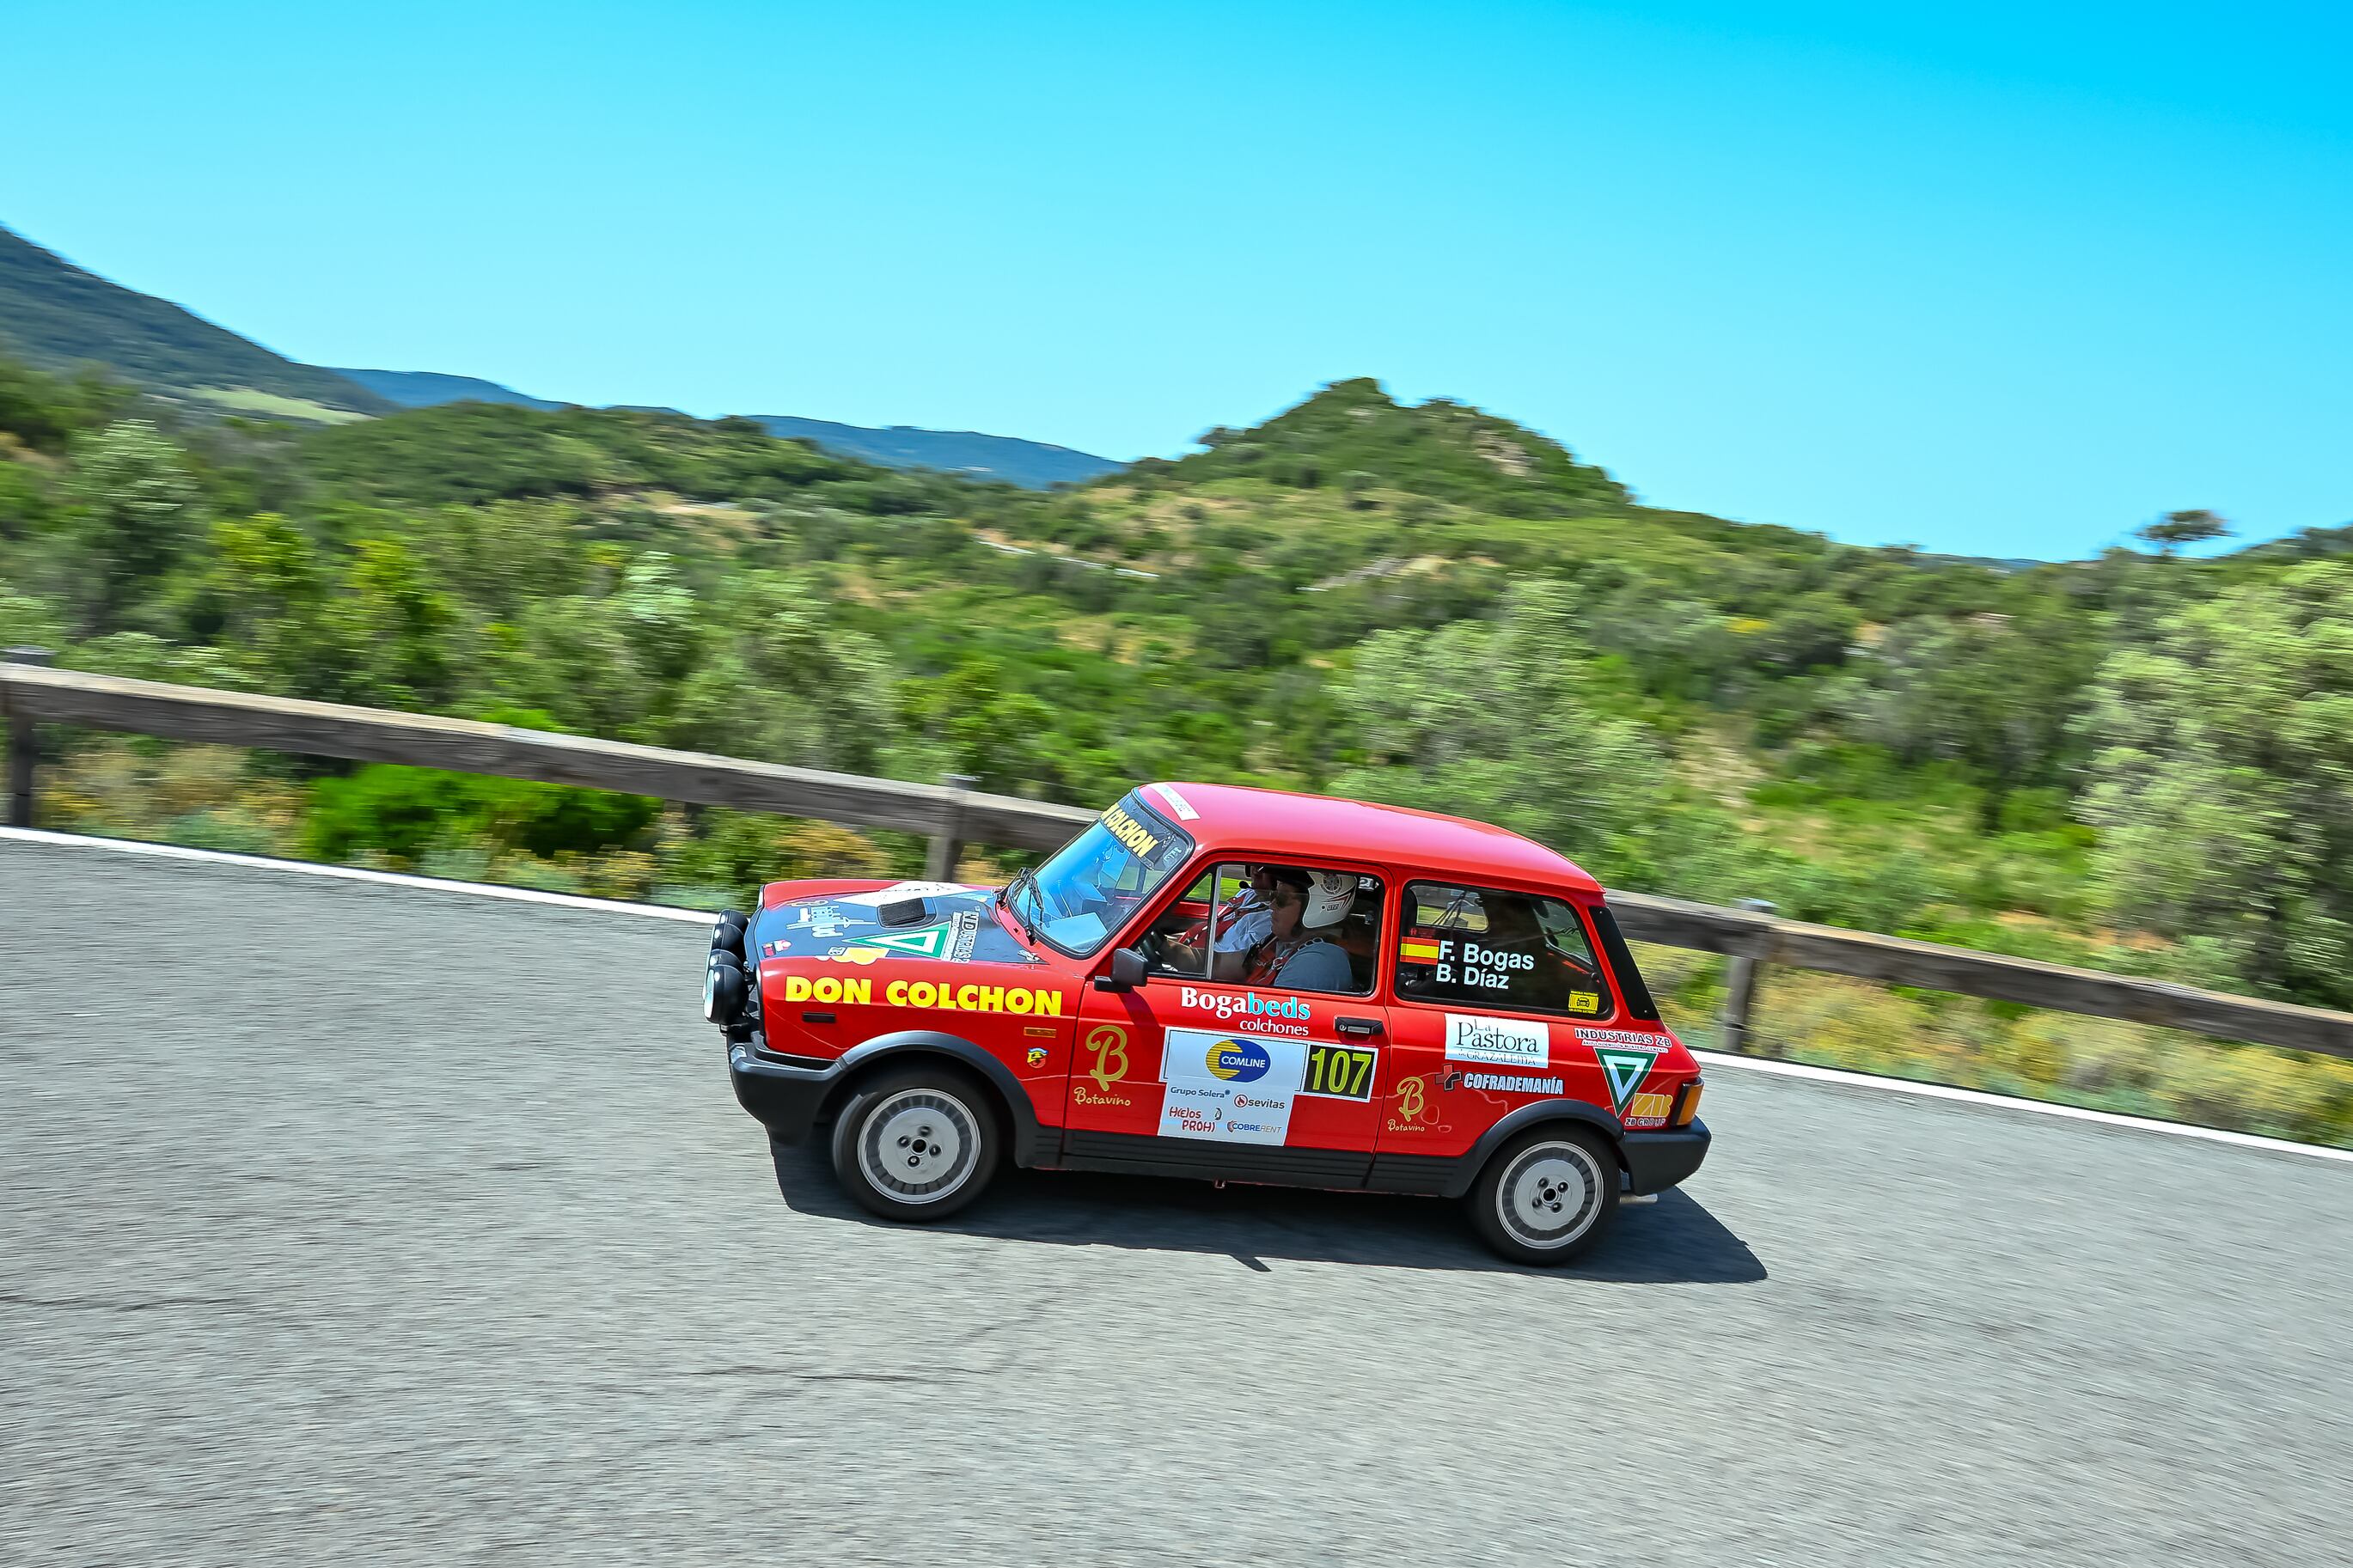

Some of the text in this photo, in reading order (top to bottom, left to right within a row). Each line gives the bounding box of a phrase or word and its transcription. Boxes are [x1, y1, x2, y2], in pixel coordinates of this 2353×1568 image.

[1439, 940, 1535, 971] F. Bogas
[1436, 963, 1510, 990] B. Díaz
[785, 975, 1062, 1017] DON COLCHON
[1181, 986, 1311, 1021] Bogabeds
[1239, 1020, 1310, 1036] colchones
[1456, 1022, 1540, 1052] Pastora
[1575, 1028, 1672, 1047] INDUSTRIAS ZB
[1220, 1055, 1266, 1068] COMLINE
[1466, 1050, 1537, 1065] GRAZALEMA
[1311, 1048, 1372, 1095] 107
[1170, 1086, 1197, 1096] Grupo
[1464, 1073, 1564, 1095] COFRADEMANÍA
[1073, 1086, 1131, 1107] Botavino
[1247, 1098, 1286, 1109] sevitas
[1387, 1119, 1425, 1132] Botavino
[1625, 1117, 1666, 1127] ZB GROUP
